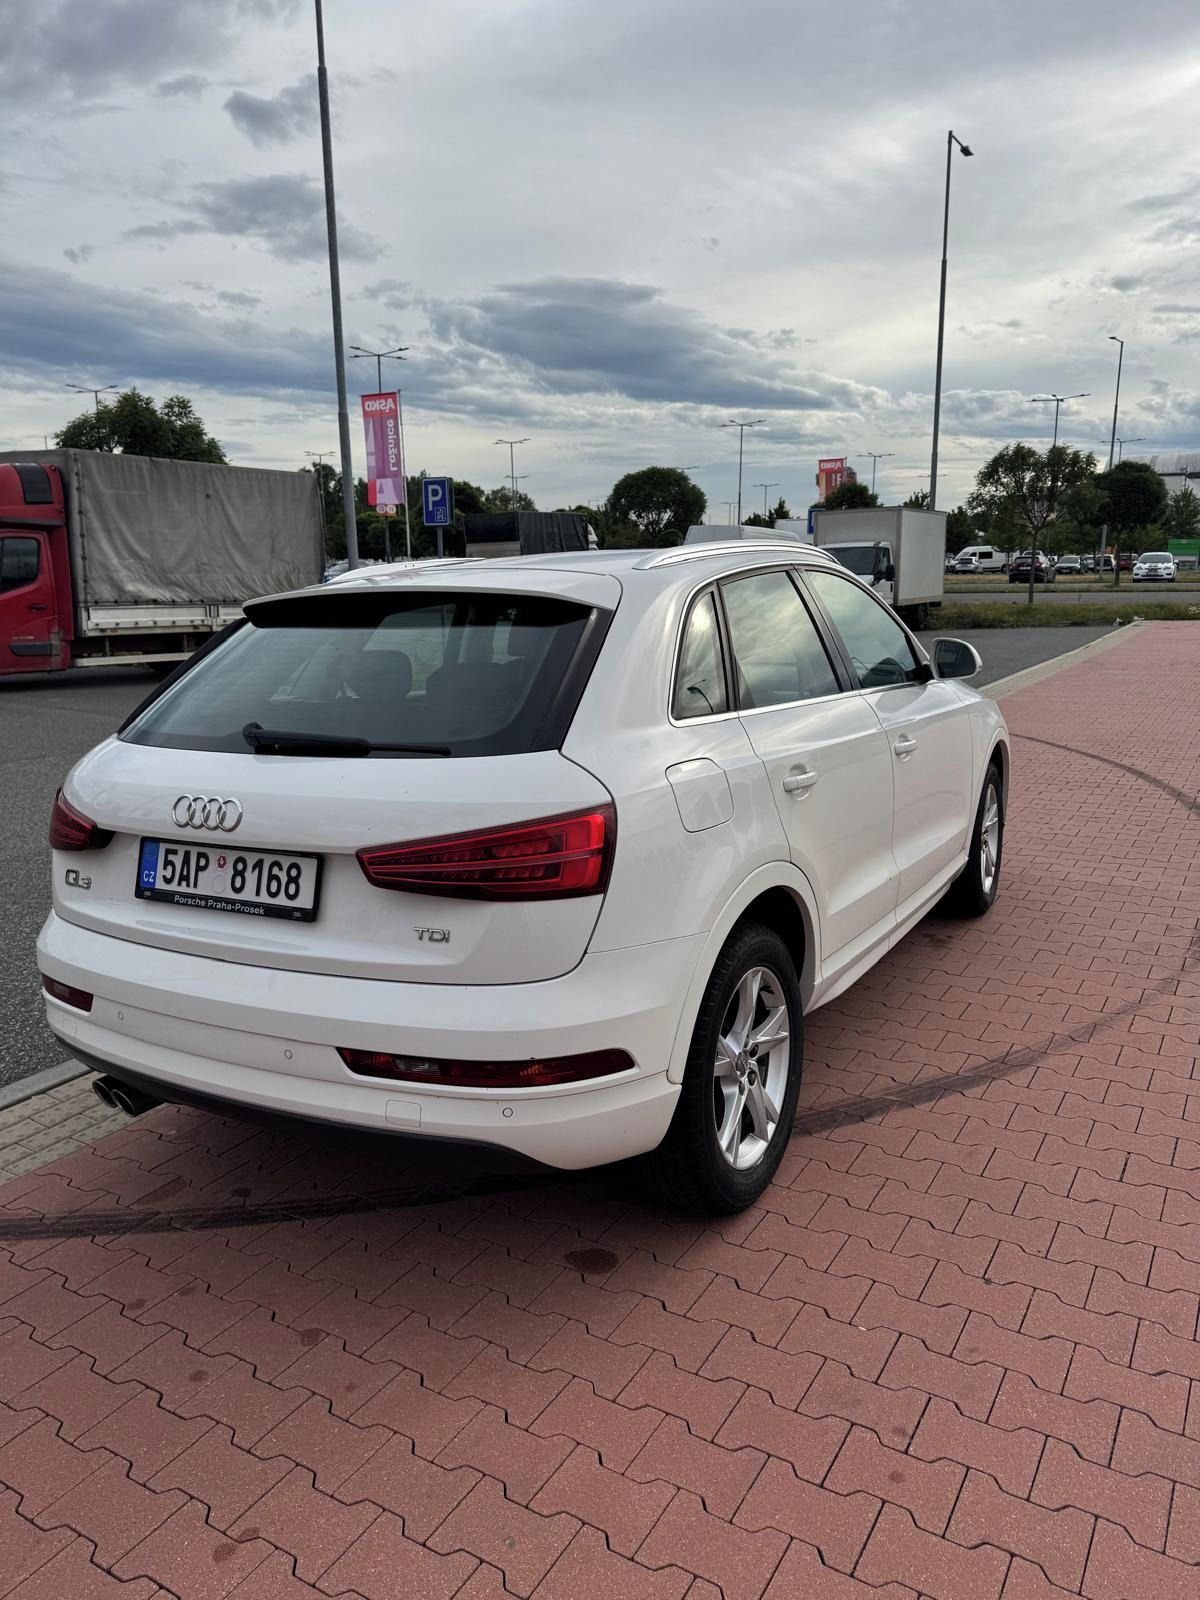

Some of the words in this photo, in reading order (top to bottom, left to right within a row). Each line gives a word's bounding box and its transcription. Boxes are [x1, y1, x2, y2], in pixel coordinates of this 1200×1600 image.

[427, 484, 442, 511] P
[65, 869, 92, 890] Q3
[143, 870, 155, 882] CZ
[162, 848, 210, 888] 5AP
[230, 856, 301, 900] 8168
[174, 895, 206, 907] Porsche
[207, 900, 265, 915] Praha-Prosek
[413, 926, 451, 943] TDI
